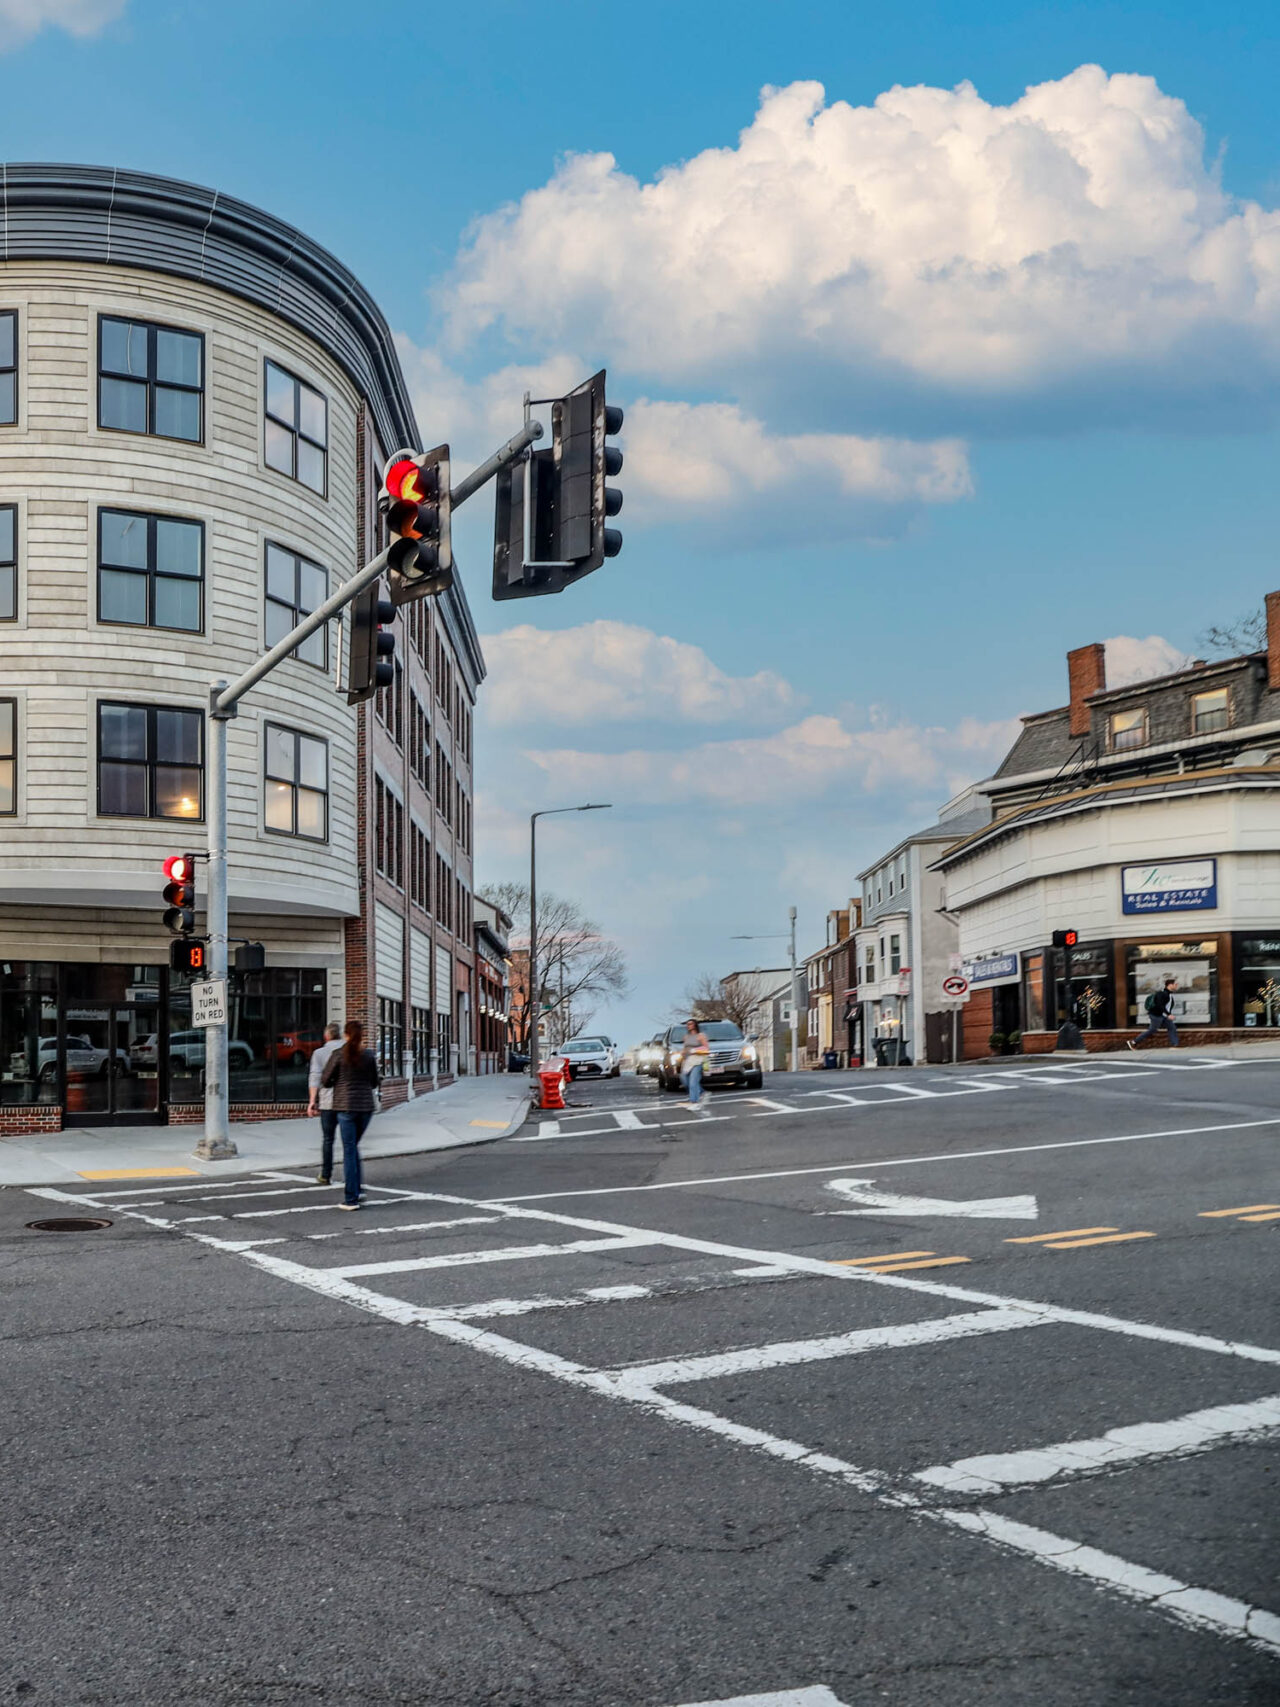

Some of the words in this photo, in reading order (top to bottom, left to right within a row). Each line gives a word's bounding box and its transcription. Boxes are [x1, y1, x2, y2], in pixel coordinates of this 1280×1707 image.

[1127, 893, 1159, 903] REAL
[1163, 889, 1209, 901] ESTATE
[190, 947, 202, 967] 8
[203, 986, 213, 995] NO
[199, 998, 219, 1008] TURN
[195, 1012, 205, 1020] ON
[208, 1009, 223, 1018] RED
